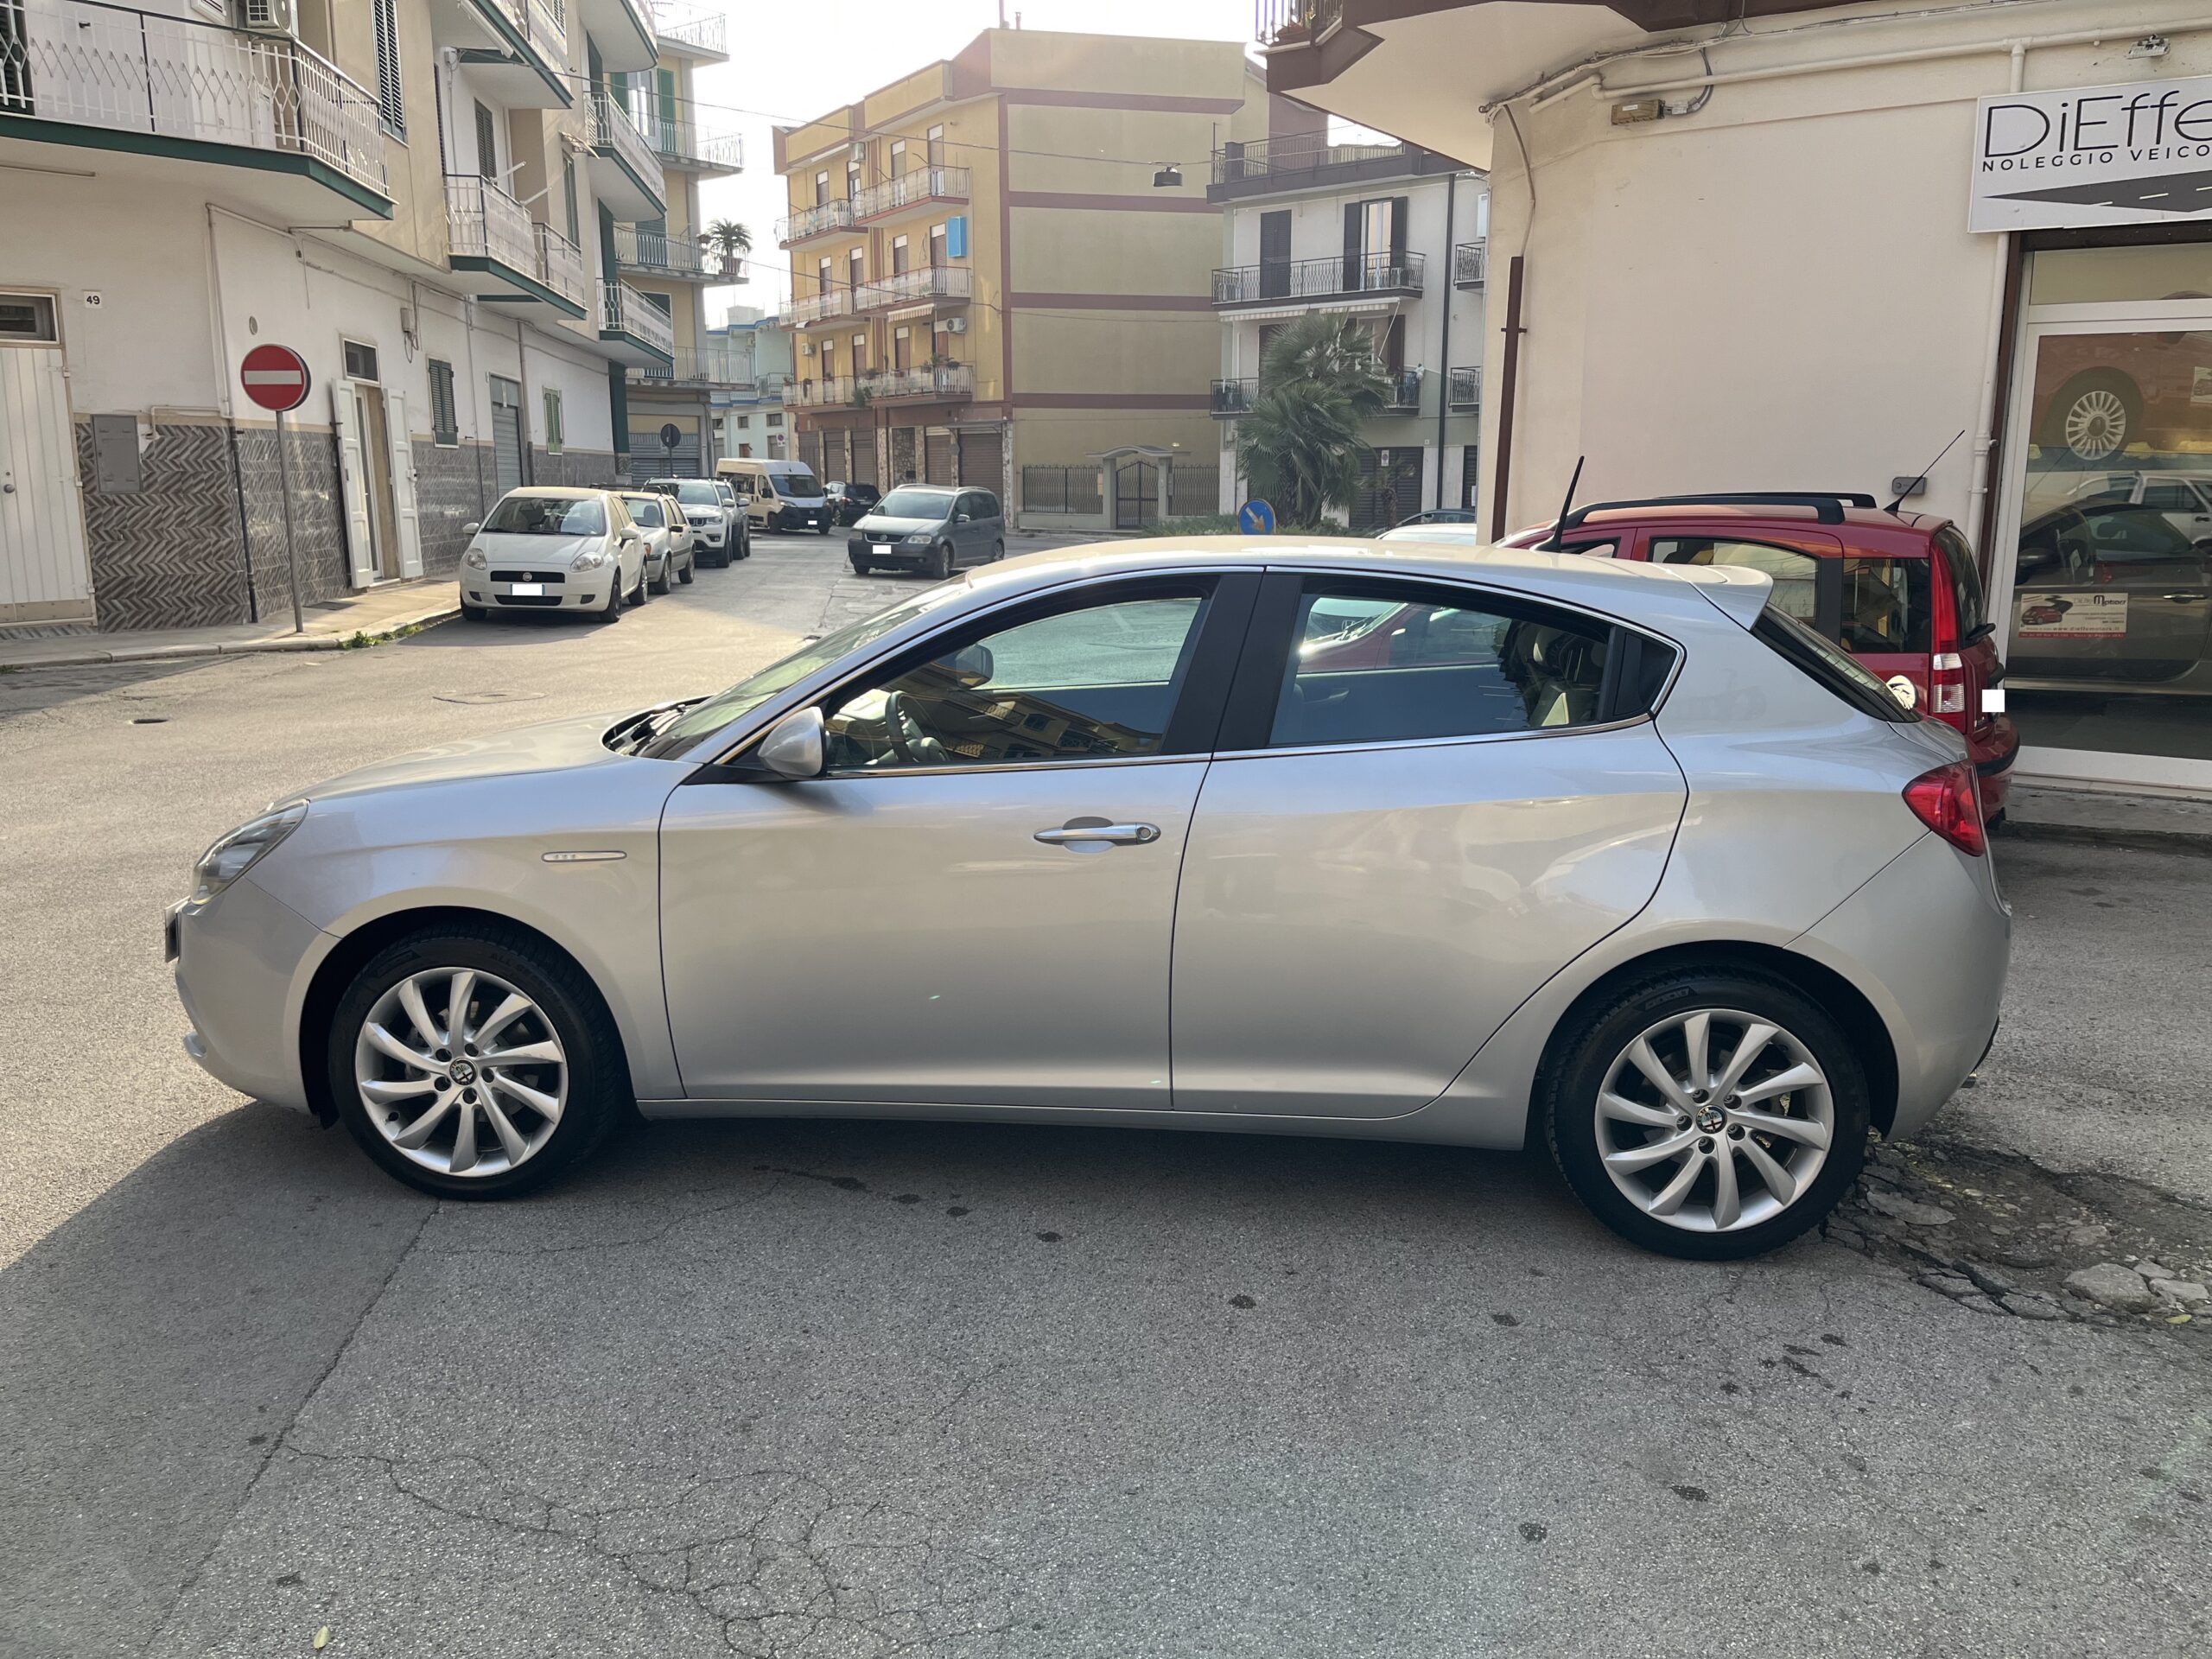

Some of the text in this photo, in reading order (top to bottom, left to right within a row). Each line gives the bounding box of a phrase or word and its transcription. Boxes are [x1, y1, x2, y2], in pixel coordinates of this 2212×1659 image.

[1985, 90, 2212, 157] DiEffe
[1982, 143, 2210, 172] NOLEGGIO VEICO
[86, 296, 100, 304] 49
